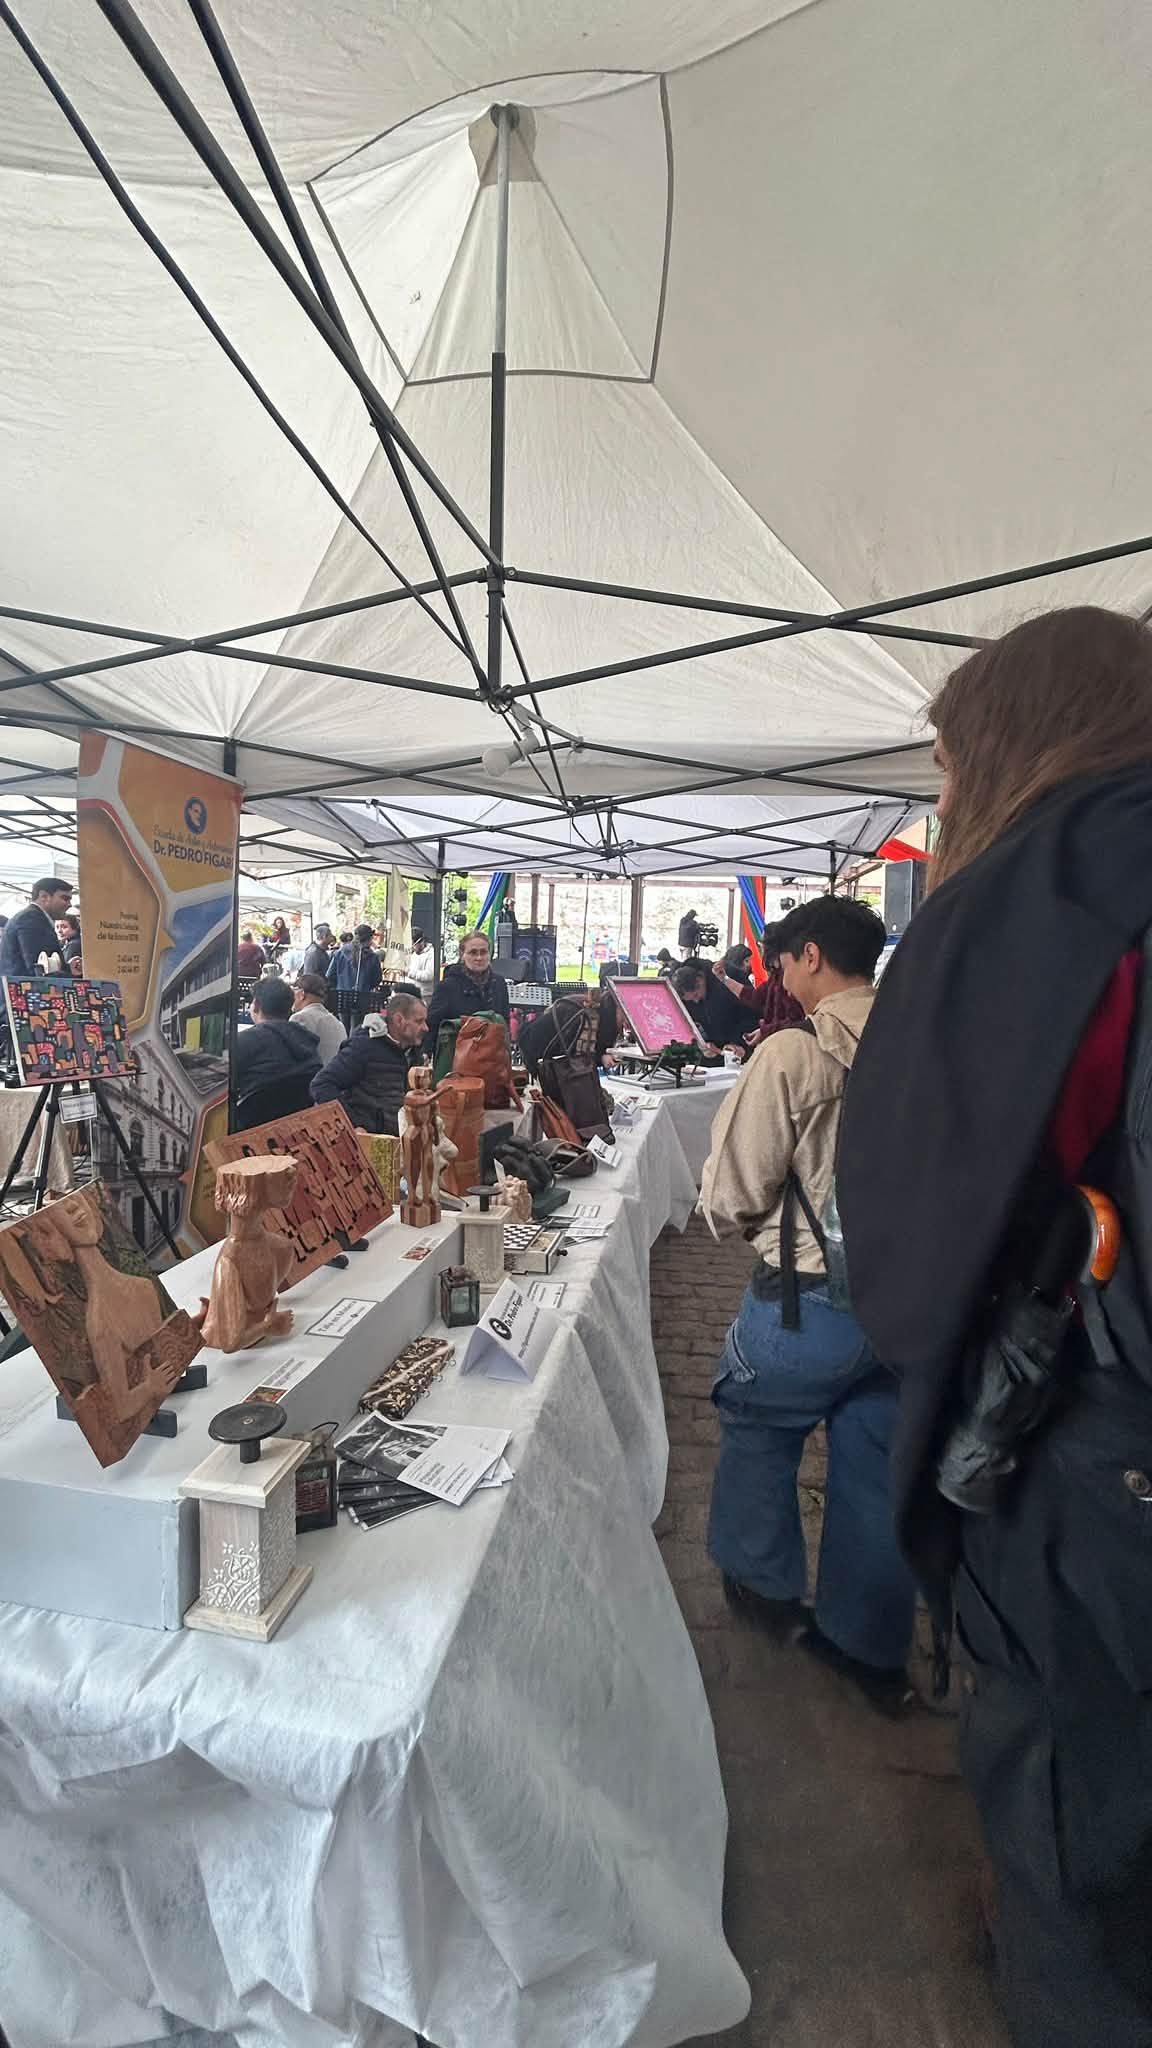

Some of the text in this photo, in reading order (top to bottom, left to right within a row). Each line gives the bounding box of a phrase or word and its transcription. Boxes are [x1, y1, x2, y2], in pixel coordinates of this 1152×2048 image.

[154, 840, 167, 856] Dr.
[168, 843, 203, 863] PEDRO
[507, 1305, 518, 1320] Pedro
